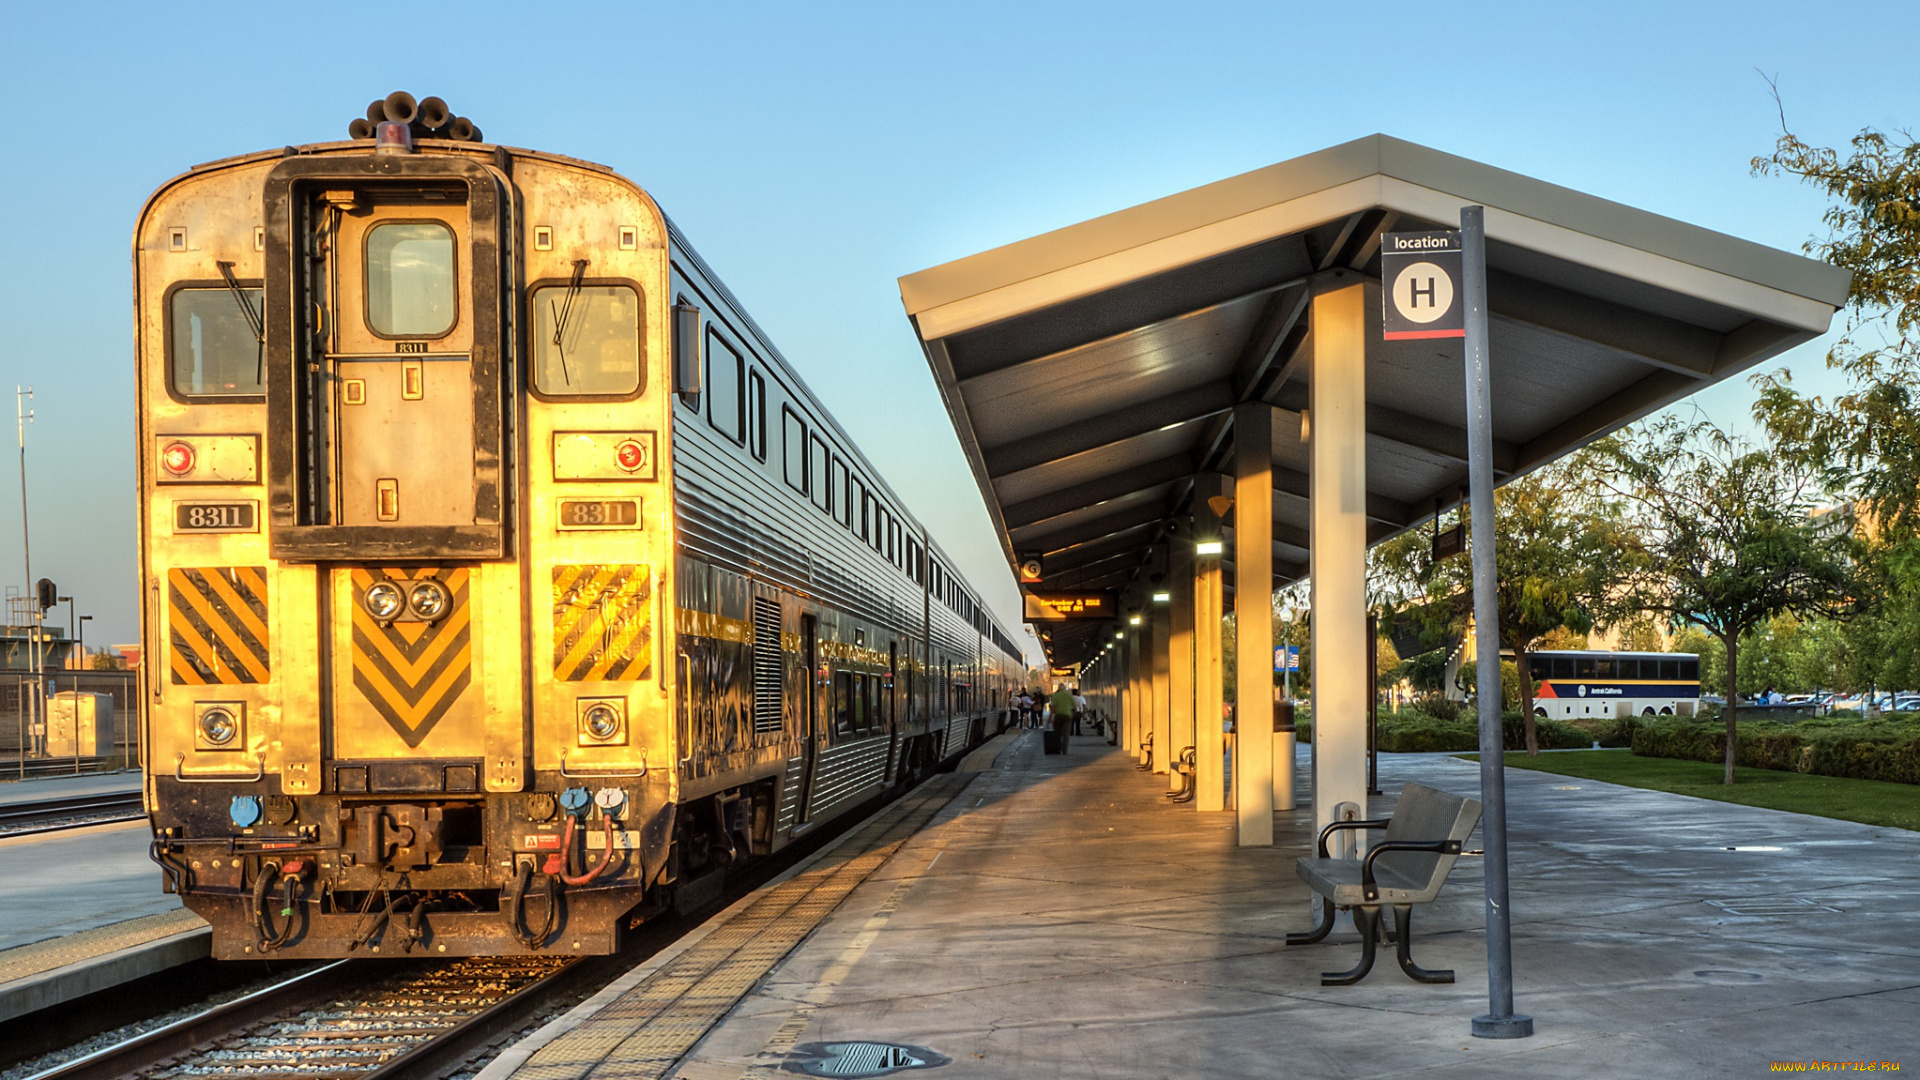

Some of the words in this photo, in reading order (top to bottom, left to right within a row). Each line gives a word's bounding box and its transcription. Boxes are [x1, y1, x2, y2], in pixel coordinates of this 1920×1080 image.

[1395, 236, 1448, 249] location
[1410, 277, 1435, 308] H
[399, 343, 424, 353] 8311
[189, 507, 242, 527] 8311
[573, 503, 625, 524] 8311
[1028, 563, 1037, 574] G
